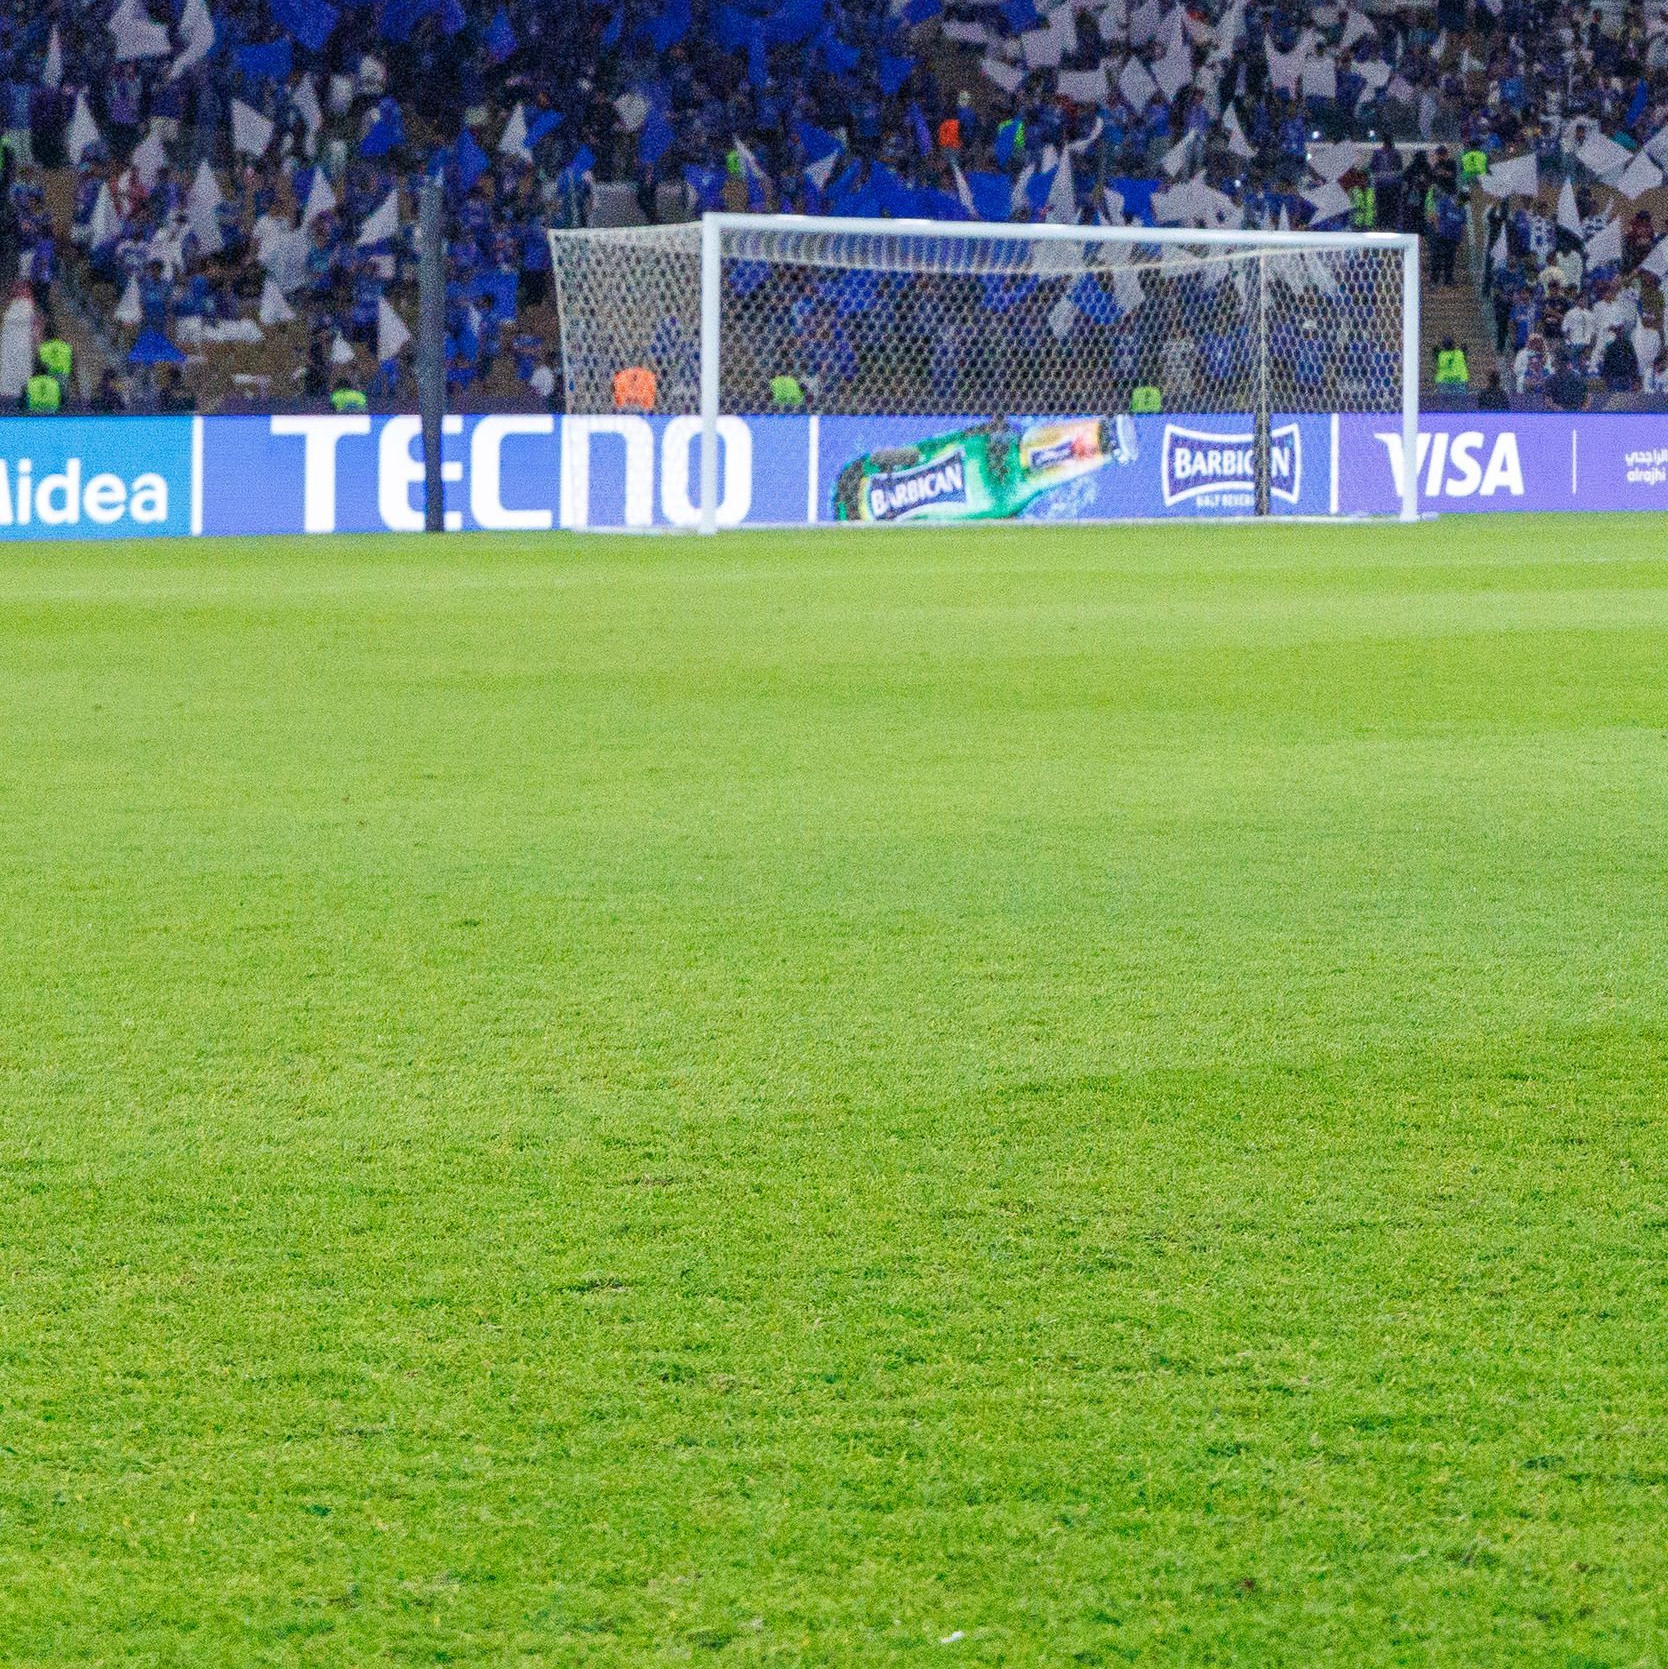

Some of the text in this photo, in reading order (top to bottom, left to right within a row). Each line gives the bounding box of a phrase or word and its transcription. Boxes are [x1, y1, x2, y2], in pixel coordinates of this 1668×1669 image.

[270, 416, 755, 532] TECNO
[870, 462, 964, 517] BARBICAN
[1174, 445, 1291, 480] BARBICN
[1374, 431, 1526, 497] VISA
